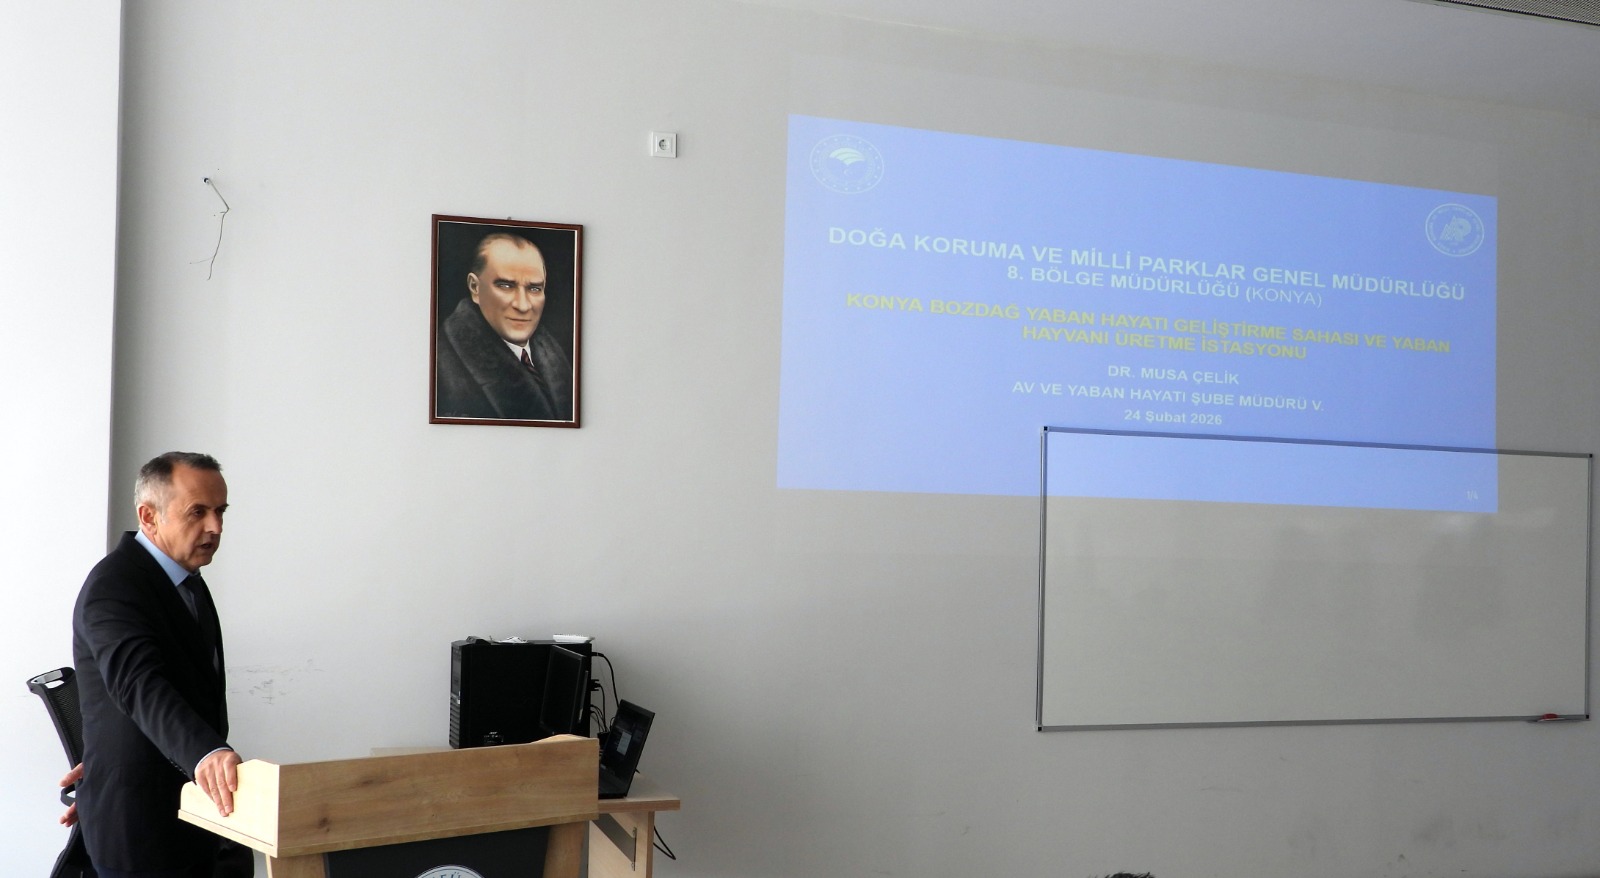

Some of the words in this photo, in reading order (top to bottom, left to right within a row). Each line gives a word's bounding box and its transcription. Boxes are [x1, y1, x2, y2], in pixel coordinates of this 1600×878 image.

[829, 227, 905, 249] DOĞA
[914, 235, 1025, 260] KORUMA
[1032, 246, 1063, 264] VE
[1071, 248, 1132, 270] MİLLİ
[1139, 256, 1246, 281] PARKLAR
[1253, 267, 1326, 288] GENEL
[1332, 274, 1465, 301] MÜDÜRLÜĞÜ
[1007, 266, 1023, 280] 8.
[1032, 267, 1104, 287] BÖLGE
[1111, 275, 1239, 298] MÜDÜRLÜĞÜ
[1245, 286, 1323, 309] (KONYA)
[847, 293, 923, 312] KONYA
[931, 299, 1020, 320] BOZDAĞ
[1026, 307, 1094, 326] YABAN
[1101, 314, 1168, 331] HAYATI
[1174, 318, 1286, 341] GELİŞTİRME
[1292, 328, 1359, 347] SAHASI
[1364, 335, 1387, 349] VE
[1394, 337, 1450, 353] YABAN
[1023, 325, 1109, 345] HAYVANI
[1115, 330, 1196, 352] ÜRETME
[1202, 338, 1307, 360] İSTASYONU
[1108, 366, 1135, 379] DR.
[1141, 368, 1188, 382] MUSA
[1192, 370, 1240, 385] ÇELİK
[1012, 382, 1034, 394] AV
[1040, 383, 1062, 395] VE
[1067, 385, 1125, 399] YABAN
[1130, 388, 1186, 403] HAYATI
[1191, 392, 1234, 407] ŞUBE
[1239, 394, 1307, 411] MÜDÜRÜ
[1312, 401, 1325, 411] V.
[1124, 409, 1141, 421] 24
[1146, 411, 1186, 424] Şubat
[1190, 413, 1223, 426] 2026
